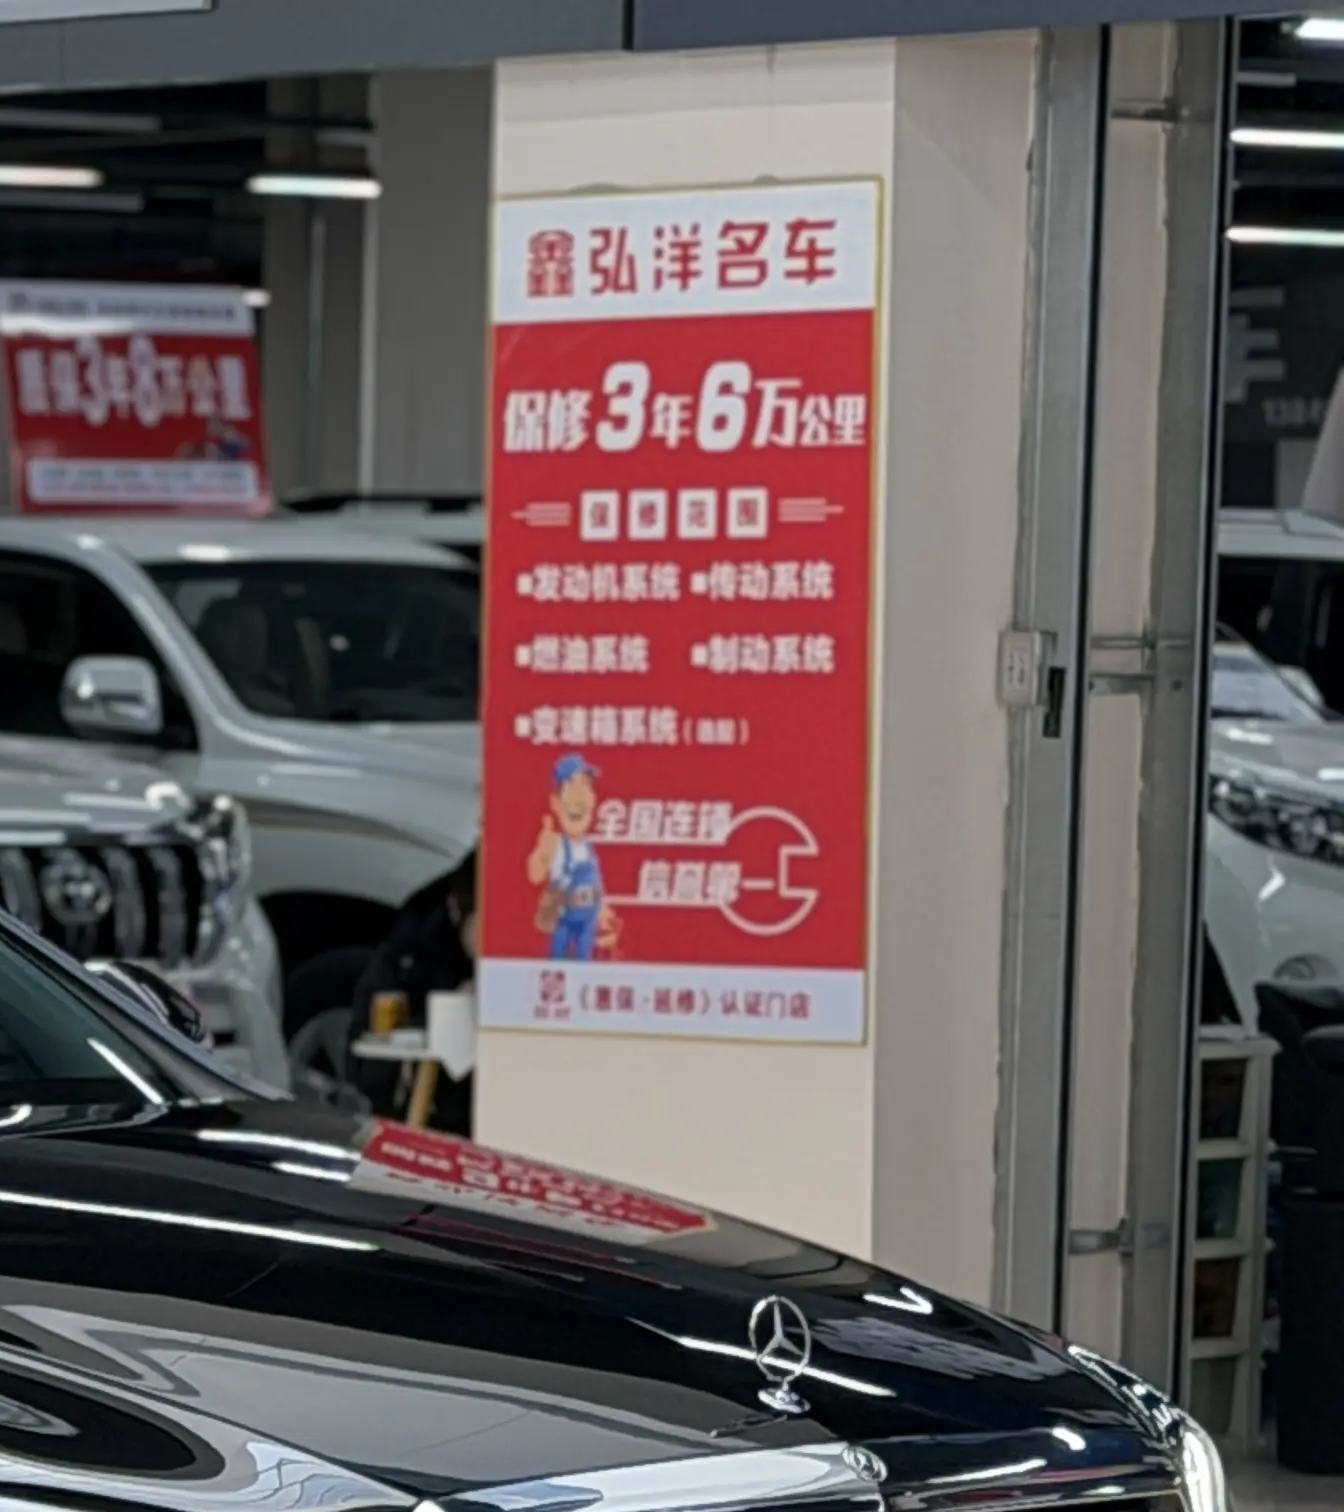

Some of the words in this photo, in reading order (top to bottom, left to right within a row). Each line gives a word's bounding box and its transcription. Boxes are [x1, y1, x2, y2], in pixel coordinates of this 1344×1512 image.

[525, 218, 837, 299] 鑫弘洋名车
[502, 360, 867, 454] 保修3年6万公里
